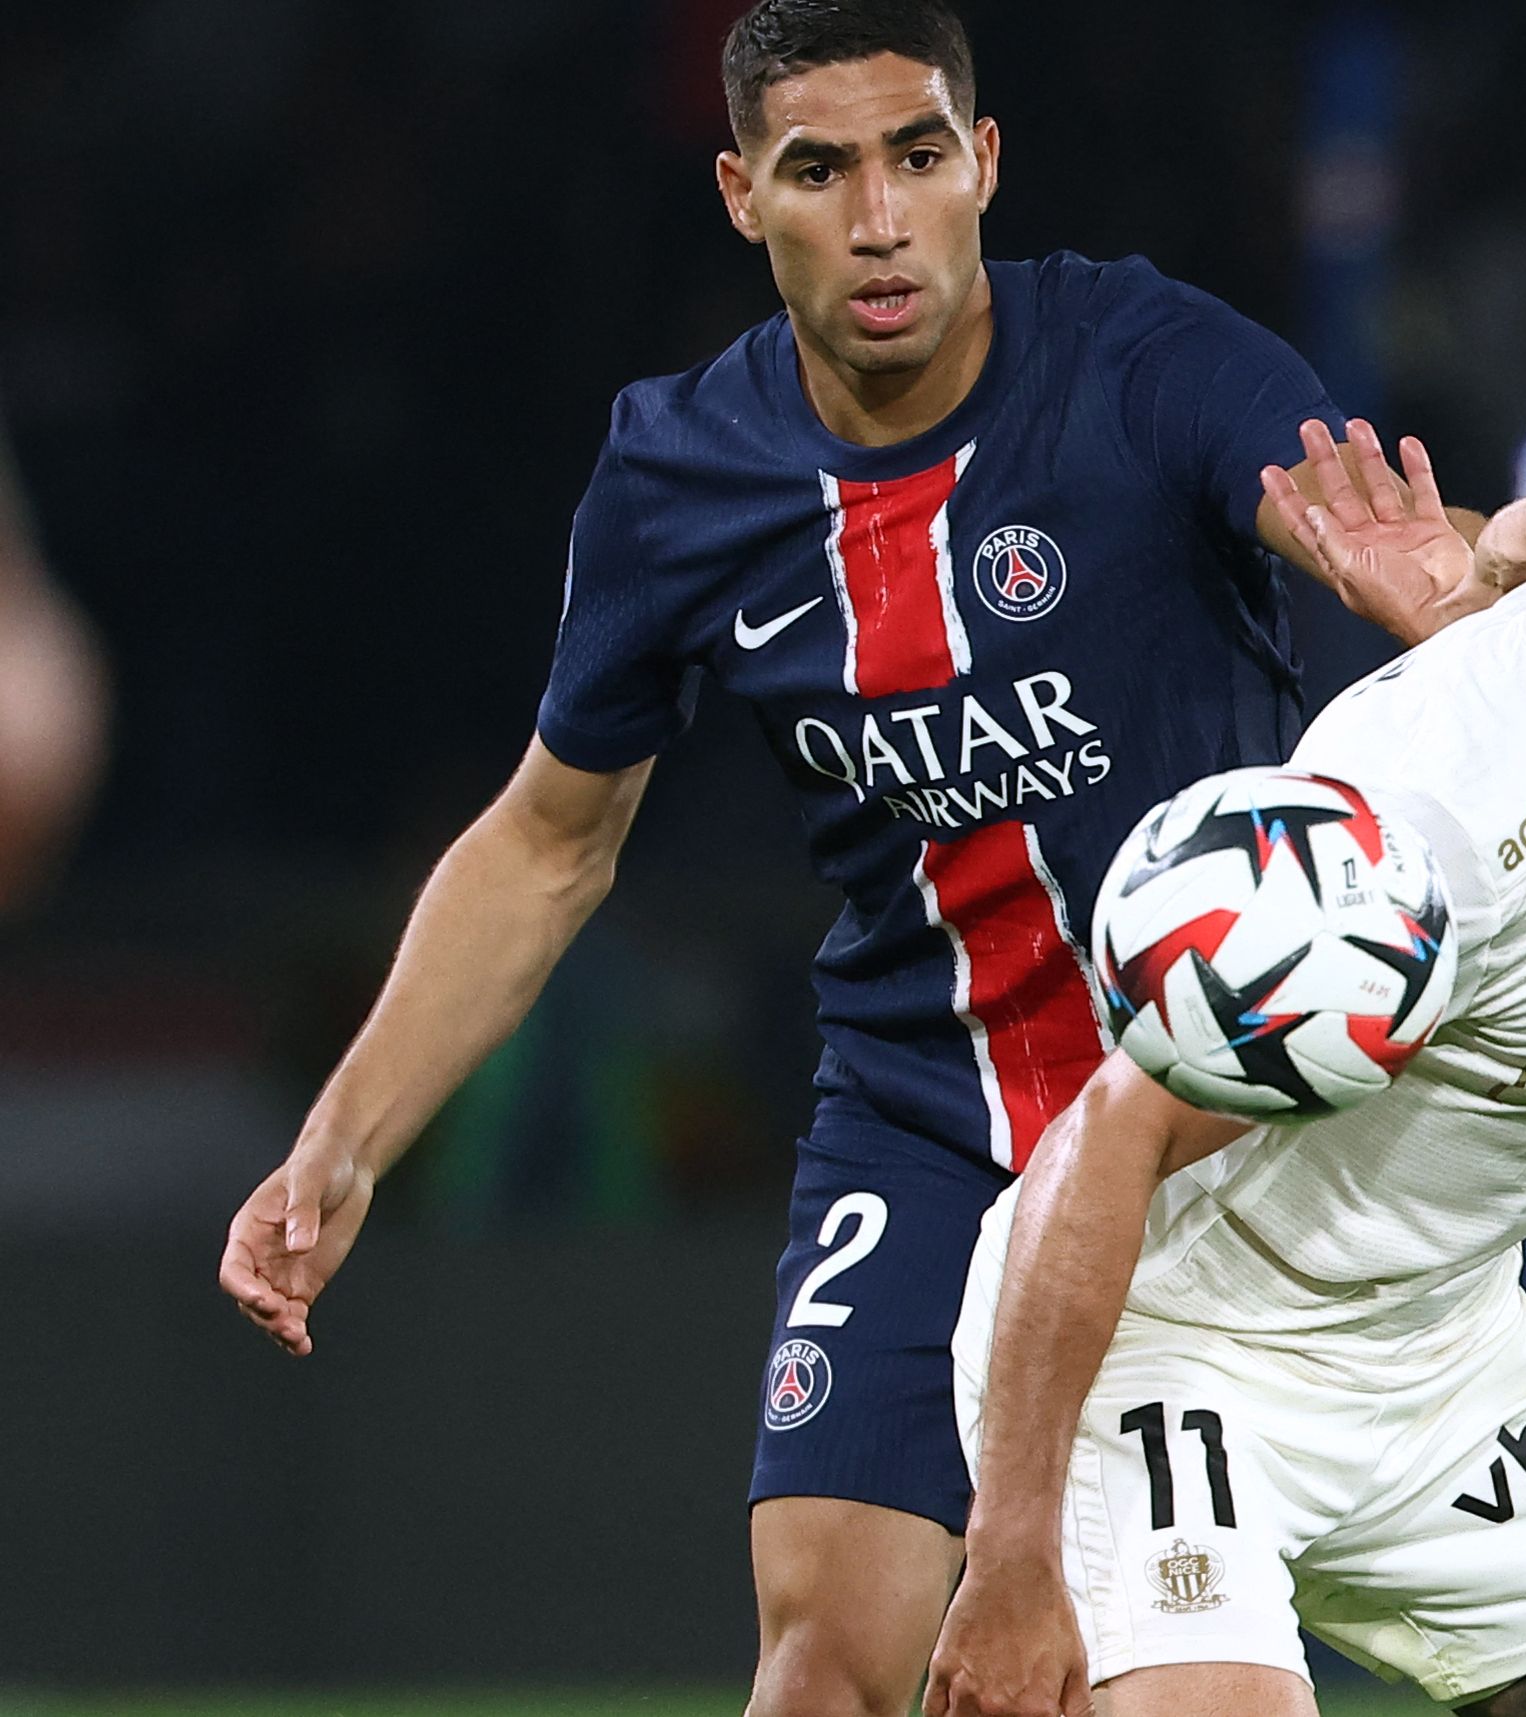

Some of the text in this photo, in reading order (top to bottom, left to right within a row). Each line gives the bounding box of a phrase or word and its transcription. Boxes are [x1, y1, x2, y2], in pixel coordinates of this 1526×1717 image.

[982, 530, 1040, 560] PARIS
[795, 670, 1097, 804] QATAR
[884, 739, 1112, 829] AIRWAYS
[786, 1192, 889, 1329] 2
[773, 1344, 820, 1369] PARIS
[1119, 1401, 1238, 1532] 11
[1167, 1557, 1199, 1569] OGC
[1168, 1566, 1201, 1577] NICE
